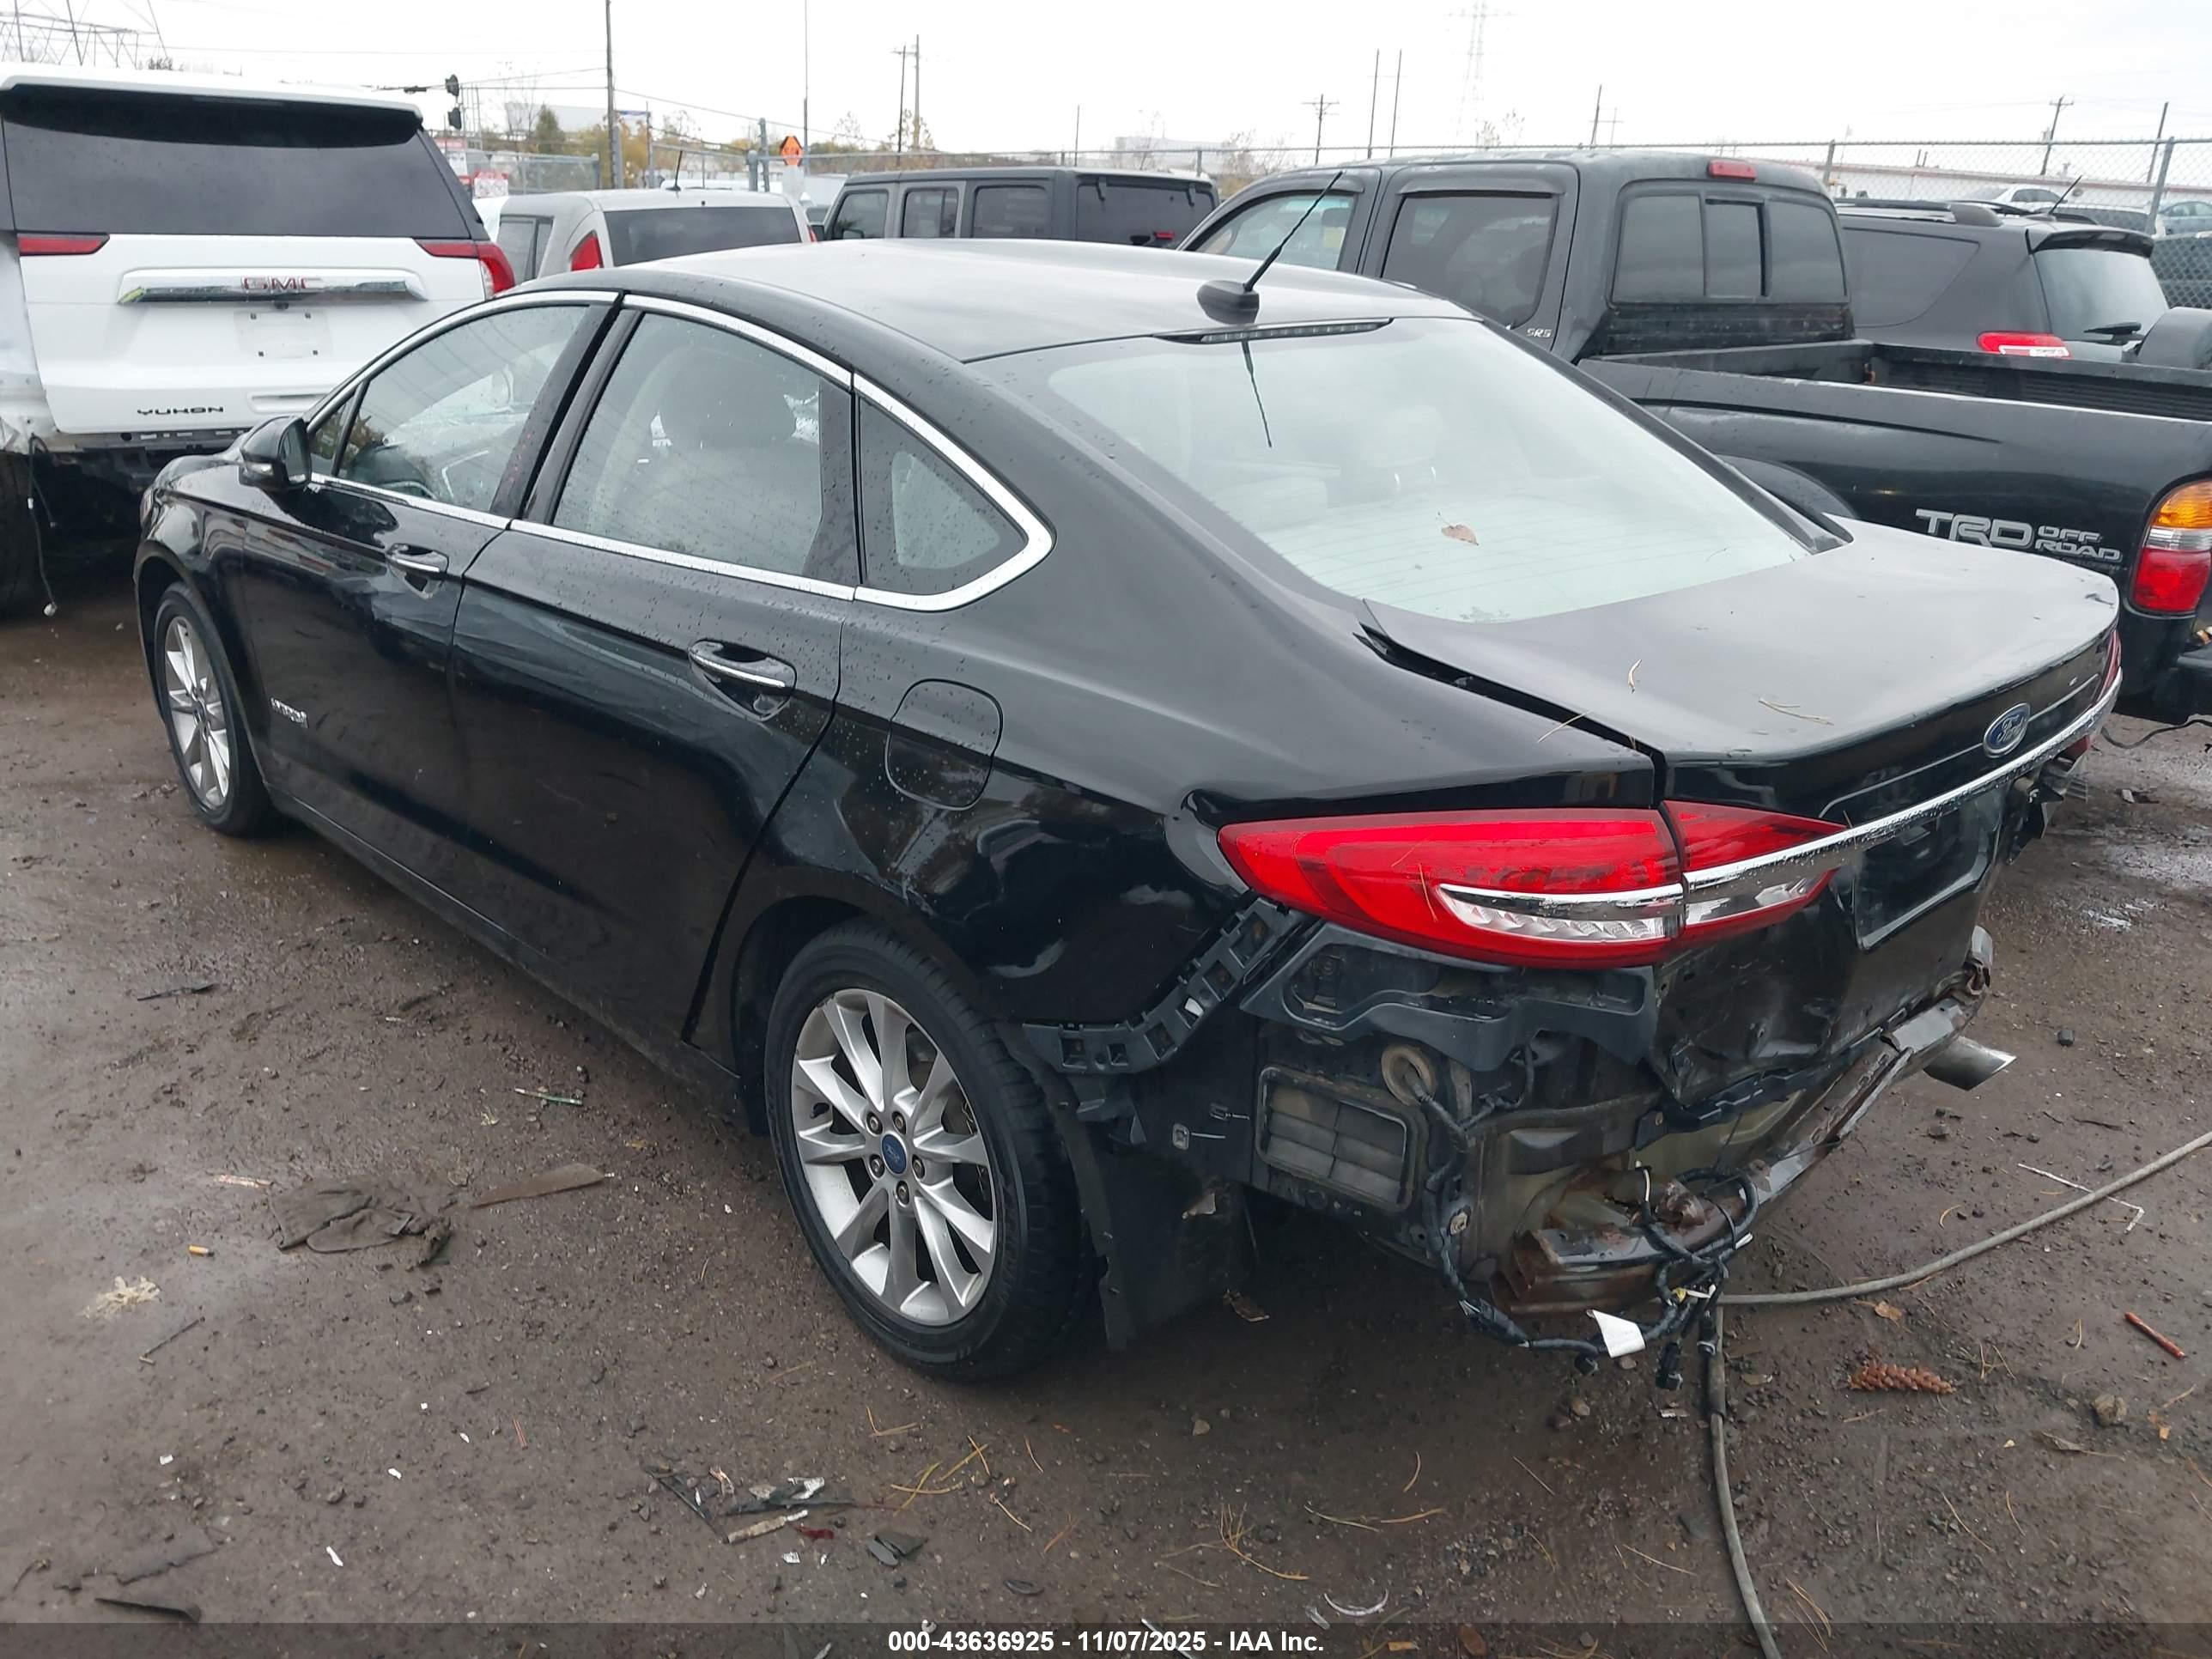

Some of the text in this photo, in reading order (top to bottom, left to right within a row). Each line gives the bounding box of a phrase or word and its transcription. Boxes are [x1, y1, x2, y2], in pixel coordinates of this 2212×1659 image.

[1915, 508, 2102, 549] TRD OFF
[2034, 538, 2124, 563] ROAD
